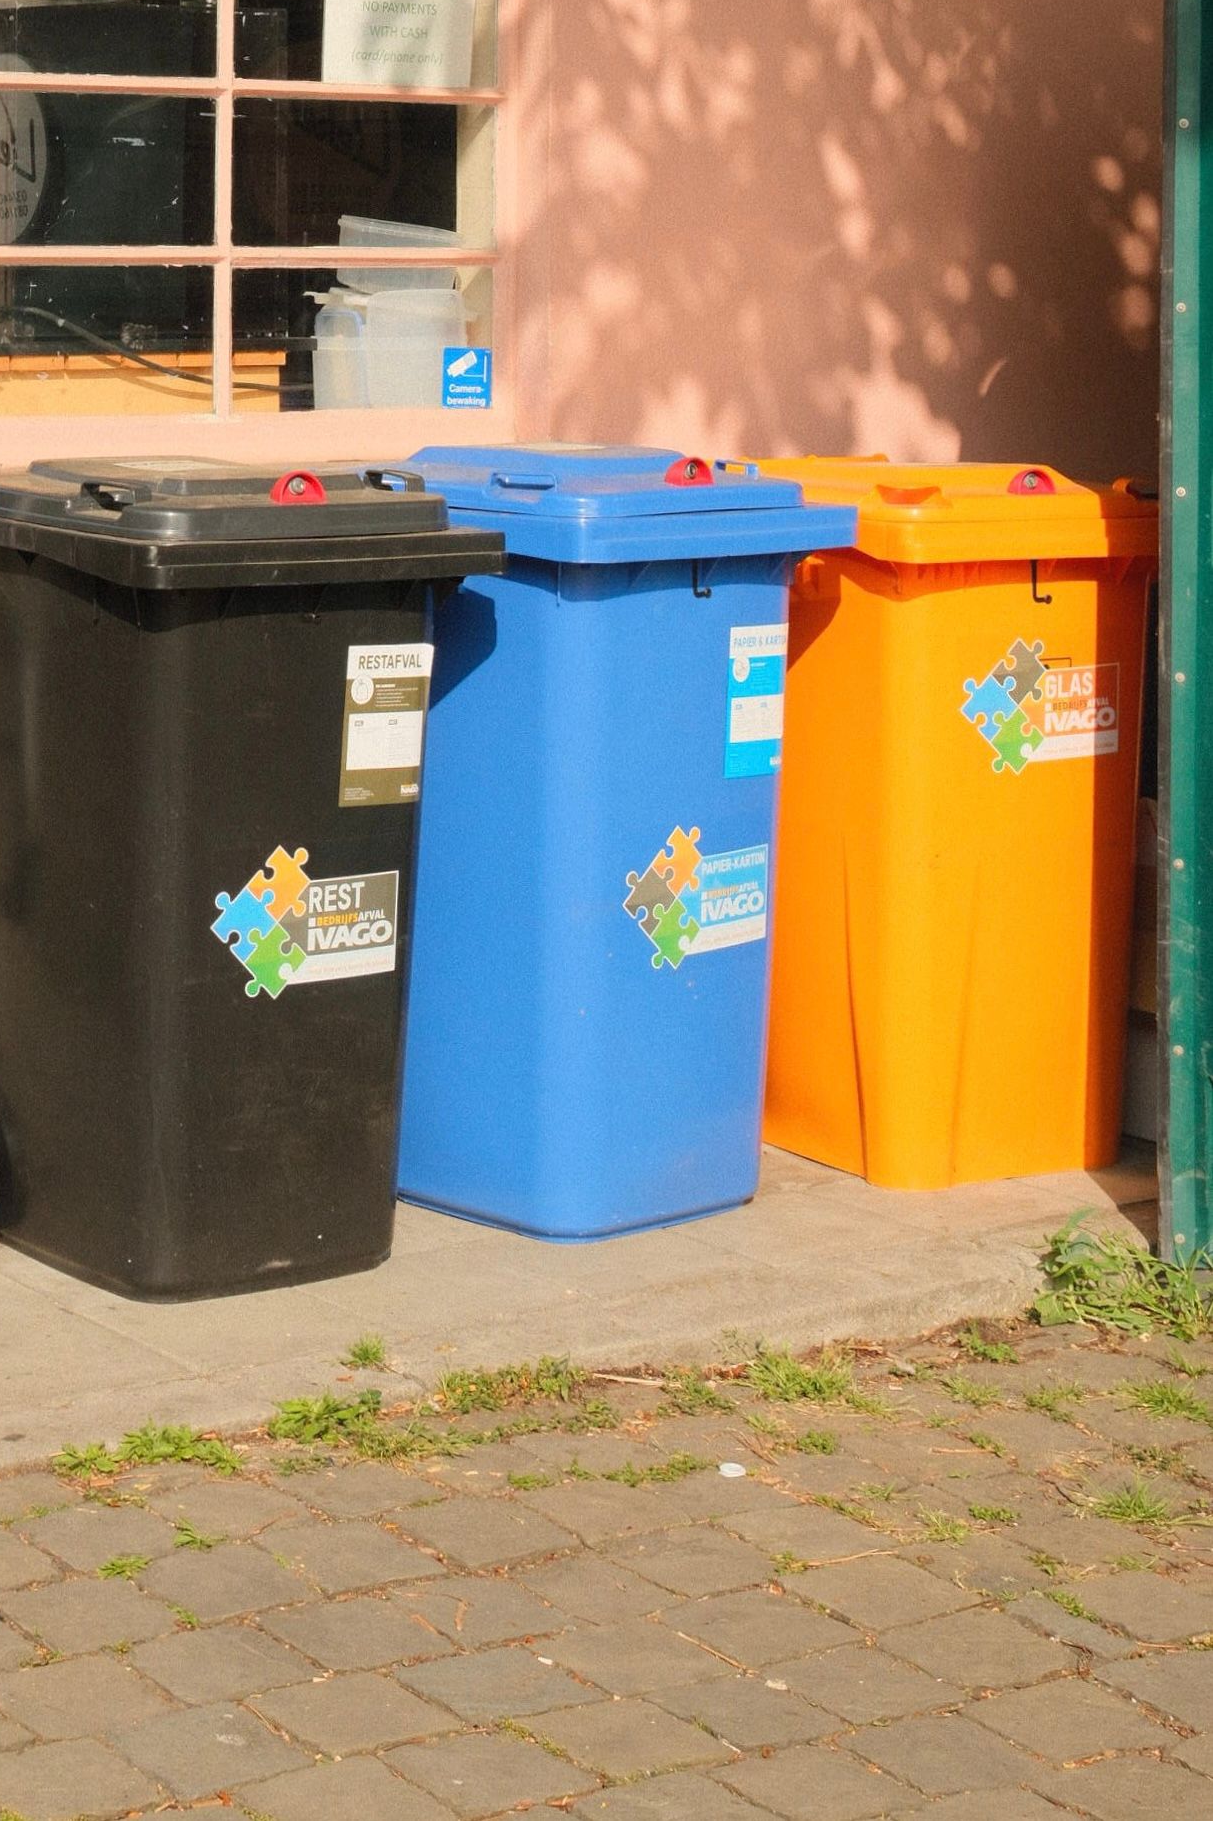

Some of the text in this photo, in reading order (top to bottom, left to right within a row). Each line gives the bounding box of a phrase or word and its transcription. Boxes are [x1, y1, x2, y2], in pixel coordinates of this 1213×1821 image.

[361, 0, 438, 16] NO PAYMENTS
[369, 25, 429, 39] WITH CASH
[446, 394, 486, 407] bewaking
[358, 653, 422, 670] RESTAFVAL
[1045, 672, 1094, 698] GLAS
[701, 851, 766, 875] PAPIER-KARTON
[308, 881, 366, 914] REST
